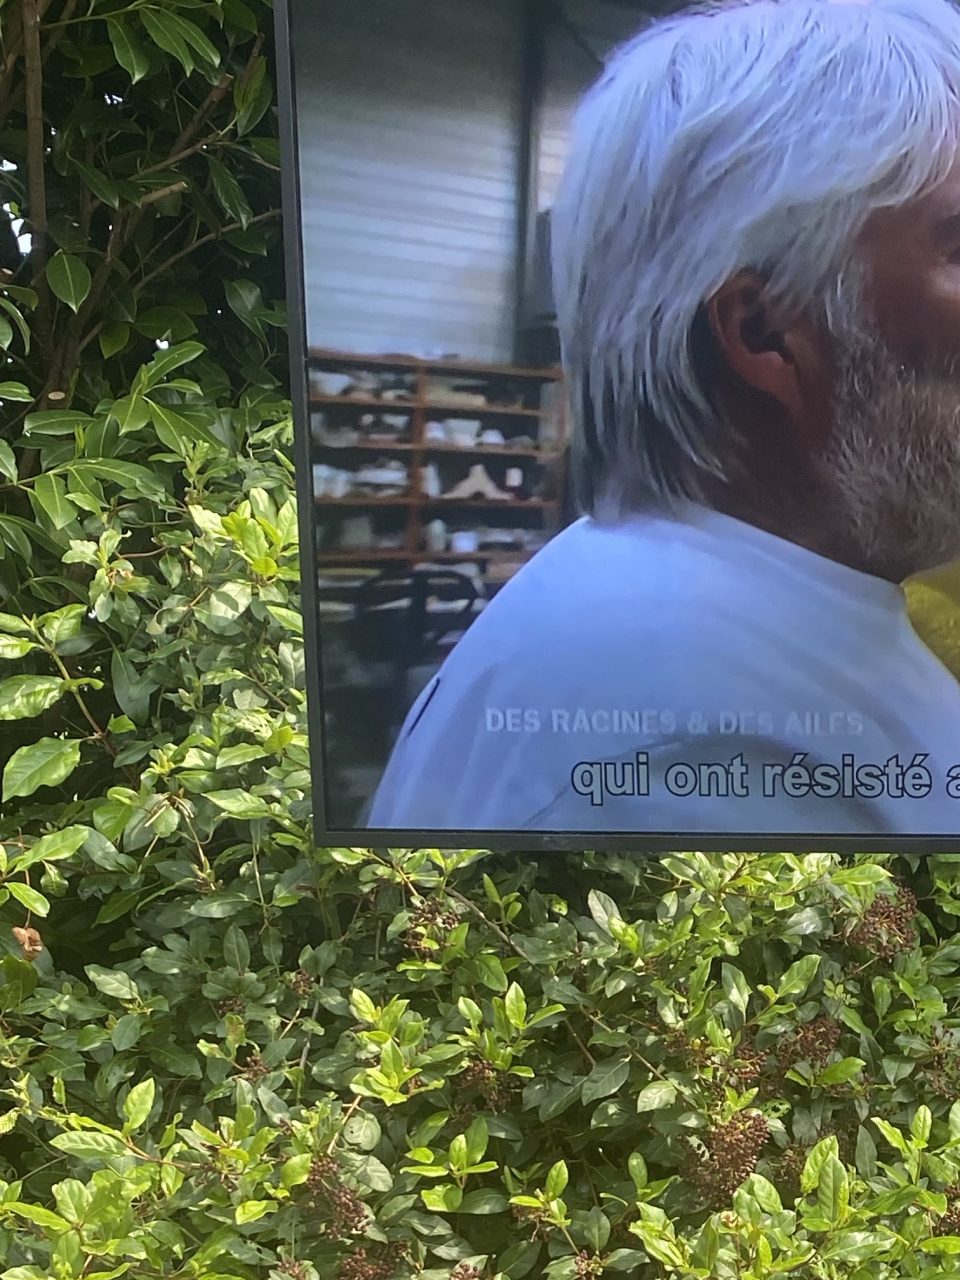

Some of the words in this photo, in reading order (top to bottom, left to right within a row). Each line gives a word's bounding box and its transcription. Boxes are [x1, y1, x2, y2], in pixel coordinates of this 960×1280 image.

[485, 708, 541, 733] DES
[552, 709, 676, 735] RACINES
[686, 711, 709, 735] &
[718, 711, 773, 736] DES
[784, 712, 863, 736] AILES
[571, 752, 650, 806] qui
[664, 756, 750, 796] ont
[762, 753, 933, 798] résisté
